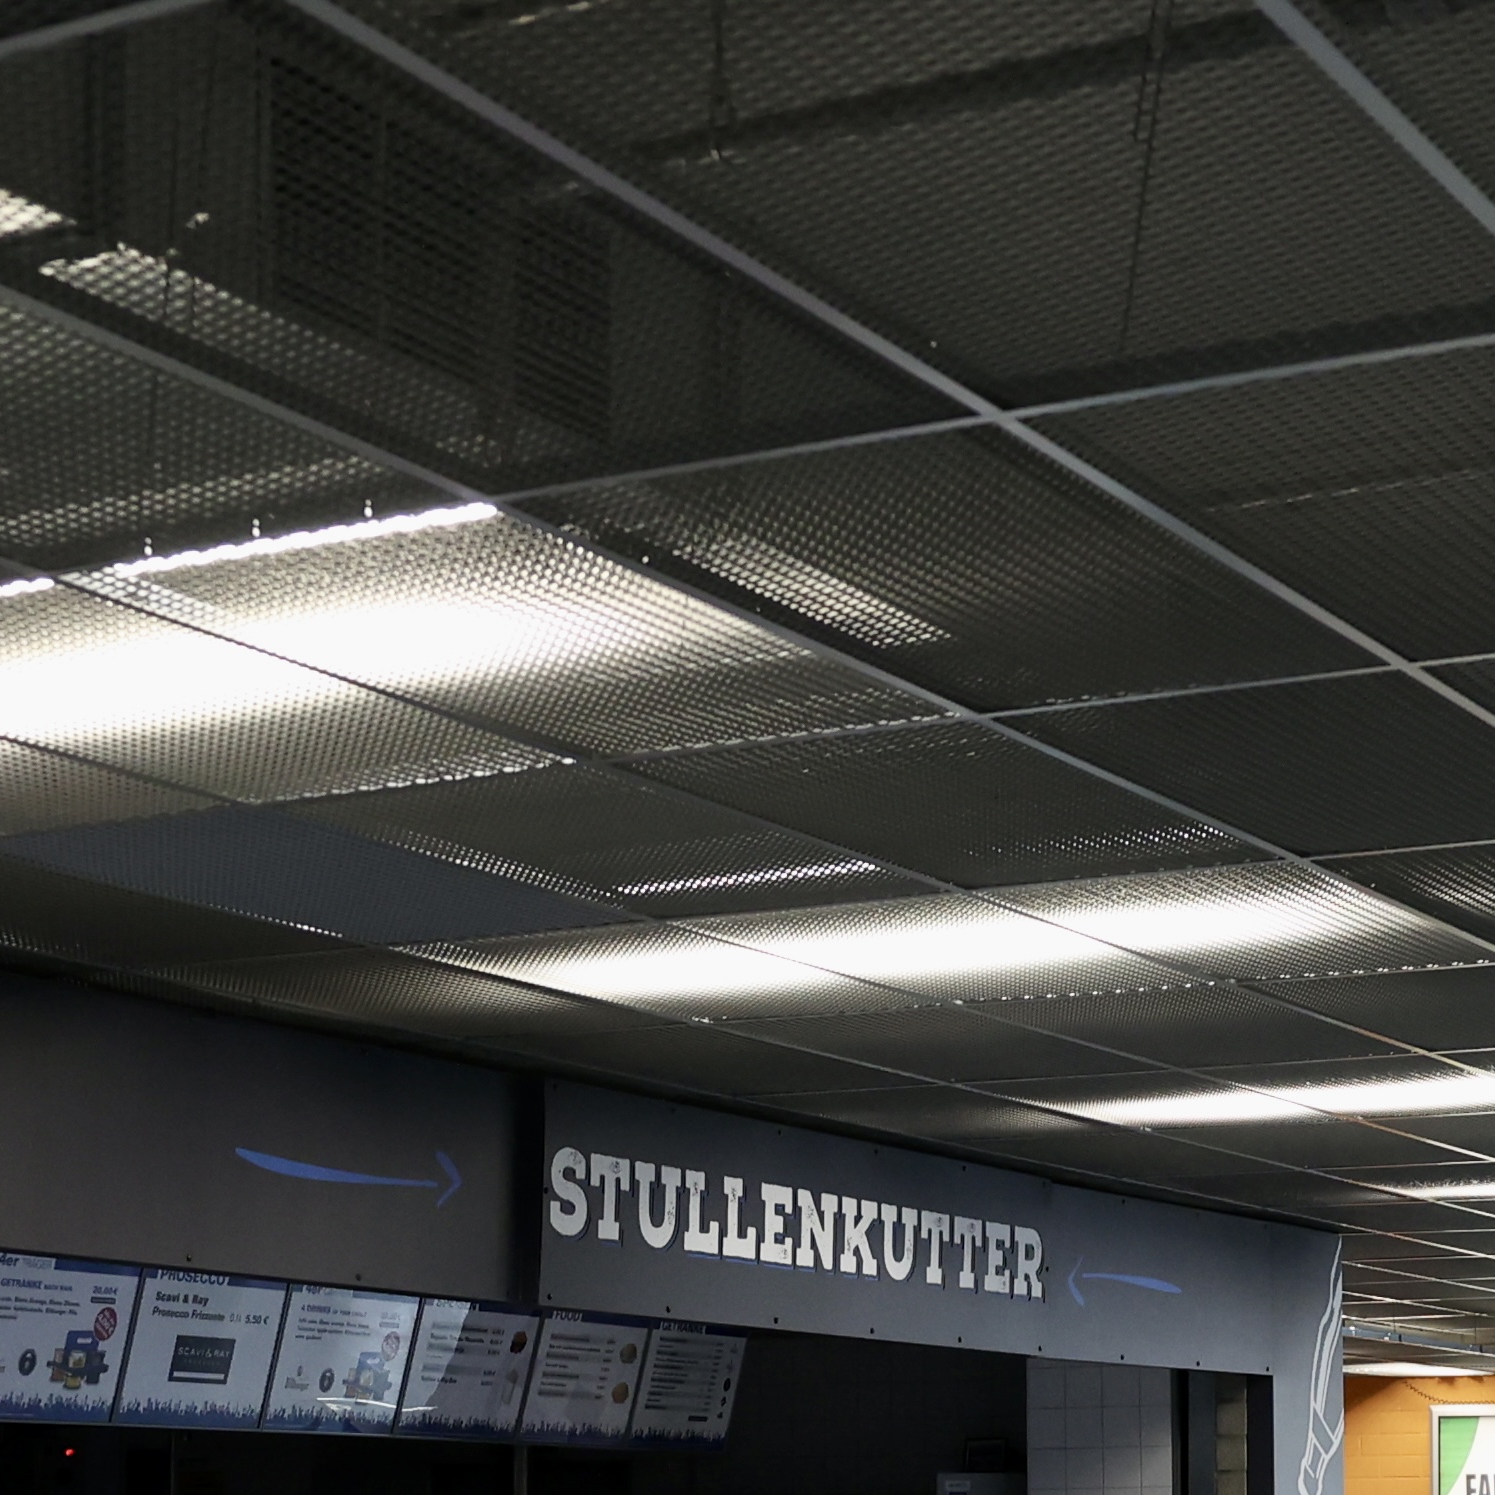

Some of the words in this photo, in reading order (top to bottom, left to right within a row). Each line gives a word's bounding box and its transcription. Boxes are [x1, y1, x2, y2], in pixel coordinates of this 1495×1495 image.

[549, 1146, 1044, 1298] STULLENKUTTER
[159, 1270, 226, 1286] PROSECCO
[156, 1291, 180, 1303] Scavi
[182, 1294, 189, 1303] &
[192, 1295, 209, 1306] Ray
[152, 1306, 190, 1318] Prosecco
[178, 1347, 204, 1356] SCAVI
[205, 1347, 212, 1358] &
[213, 1349, 230, 1358] RAY
